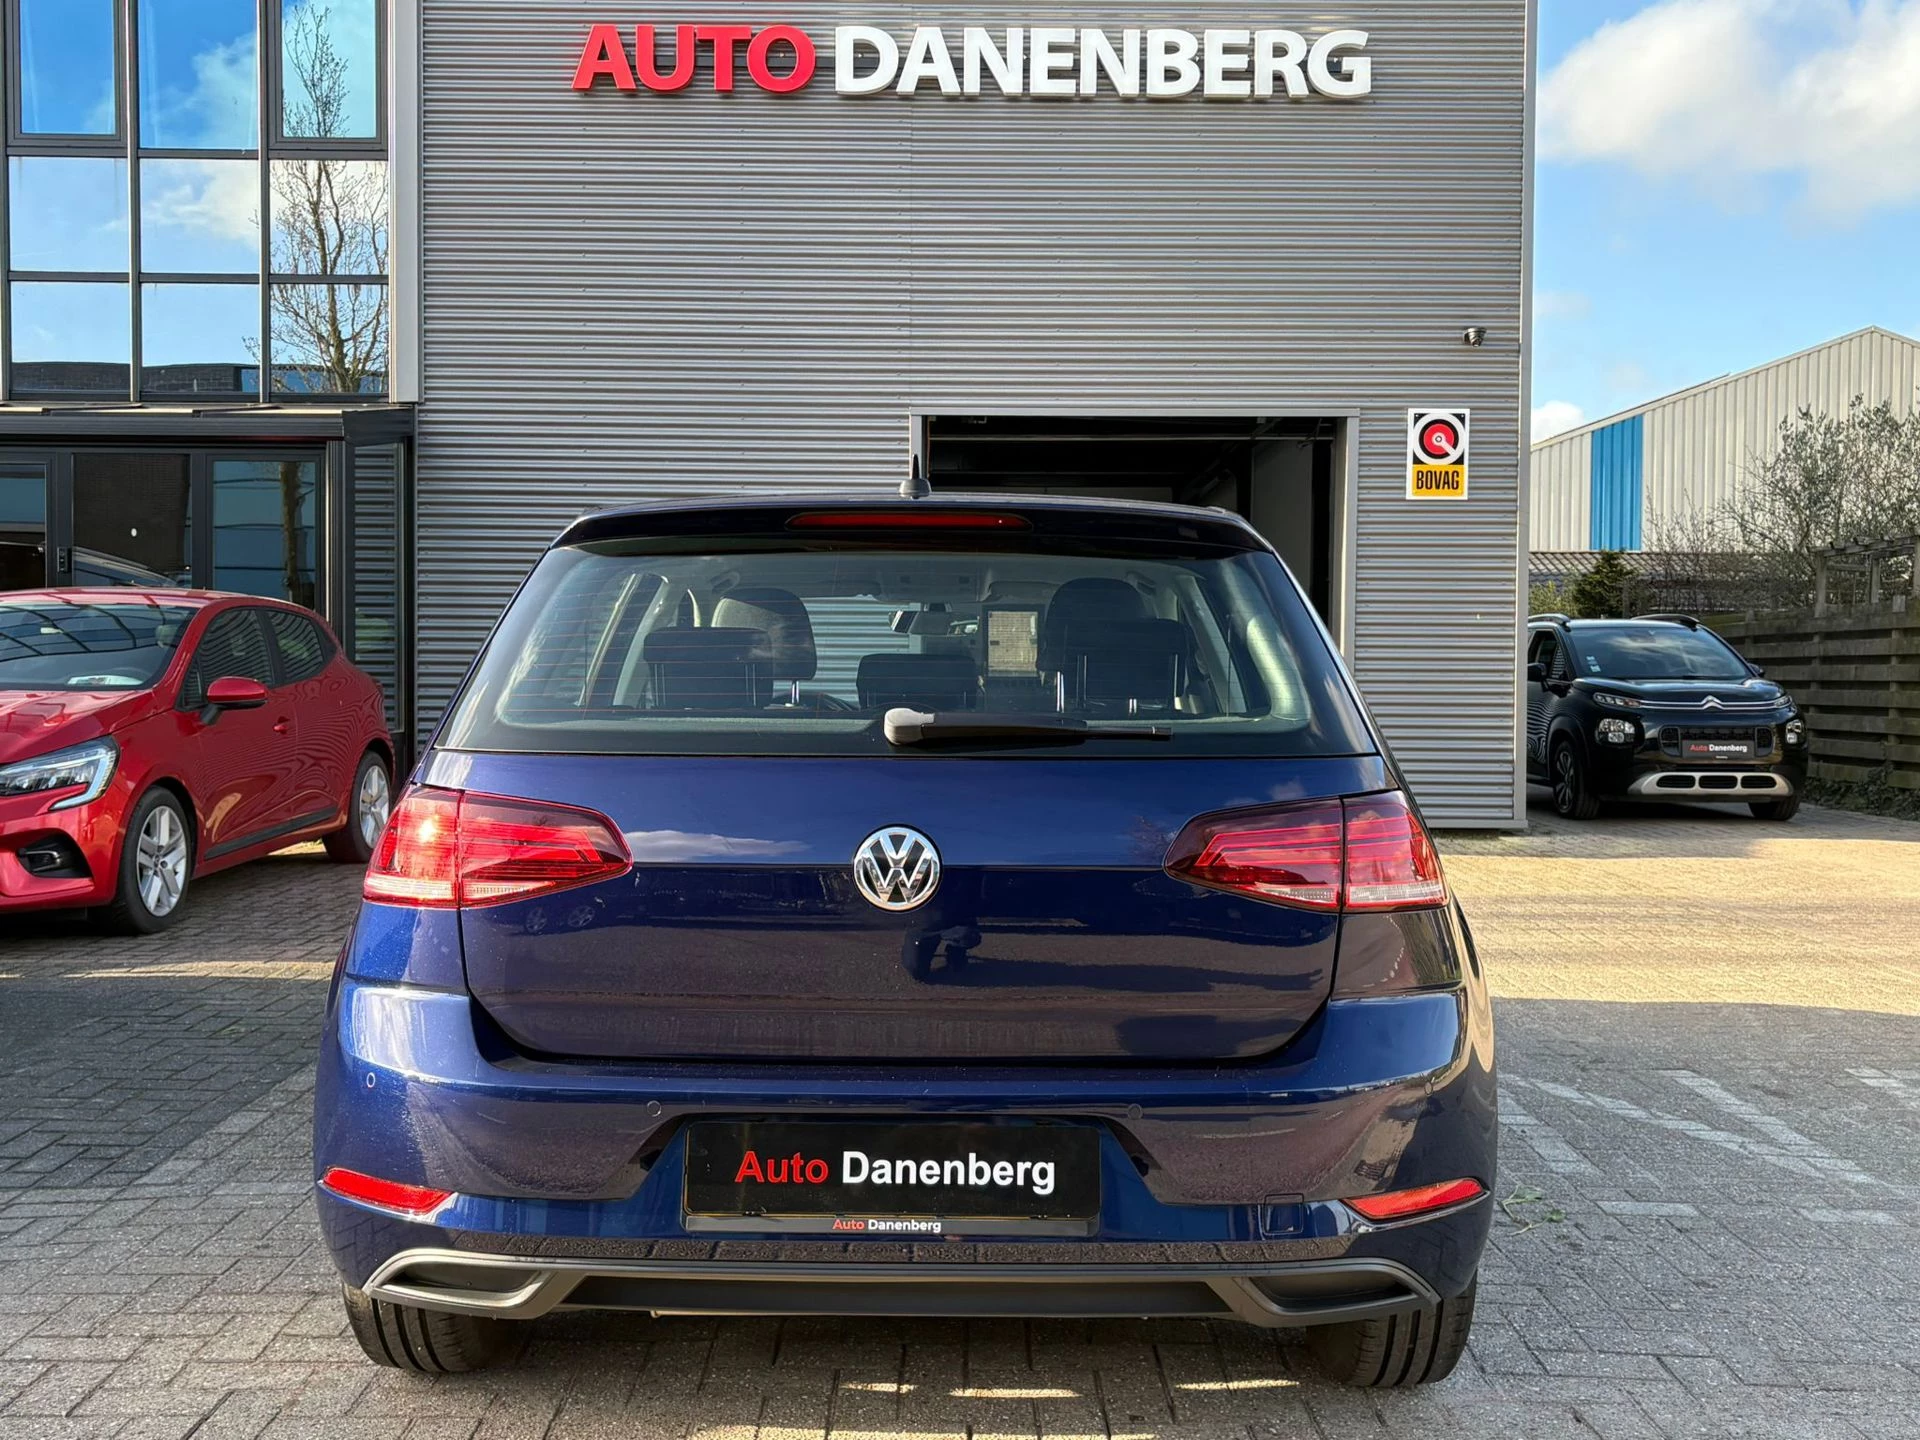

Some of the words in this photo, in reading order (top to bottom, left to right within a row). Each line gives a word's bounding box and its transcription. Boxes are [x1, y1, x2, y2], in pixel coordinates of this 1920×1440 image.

[573, 24, 816, 93] AUTO
[834, 26, 1371, 98] DANENBERG
[1416, 470, 1460, 490] BOVAG
[1708, 744, 1748, 753] Danenberg
[735, 1150, 829, 1184] Auto
[842, 1150, 1056, 1195] Danenberg
[832, 1218, 865, 1231] Auto
[867, 1219, 942, 1233] Danenberg
